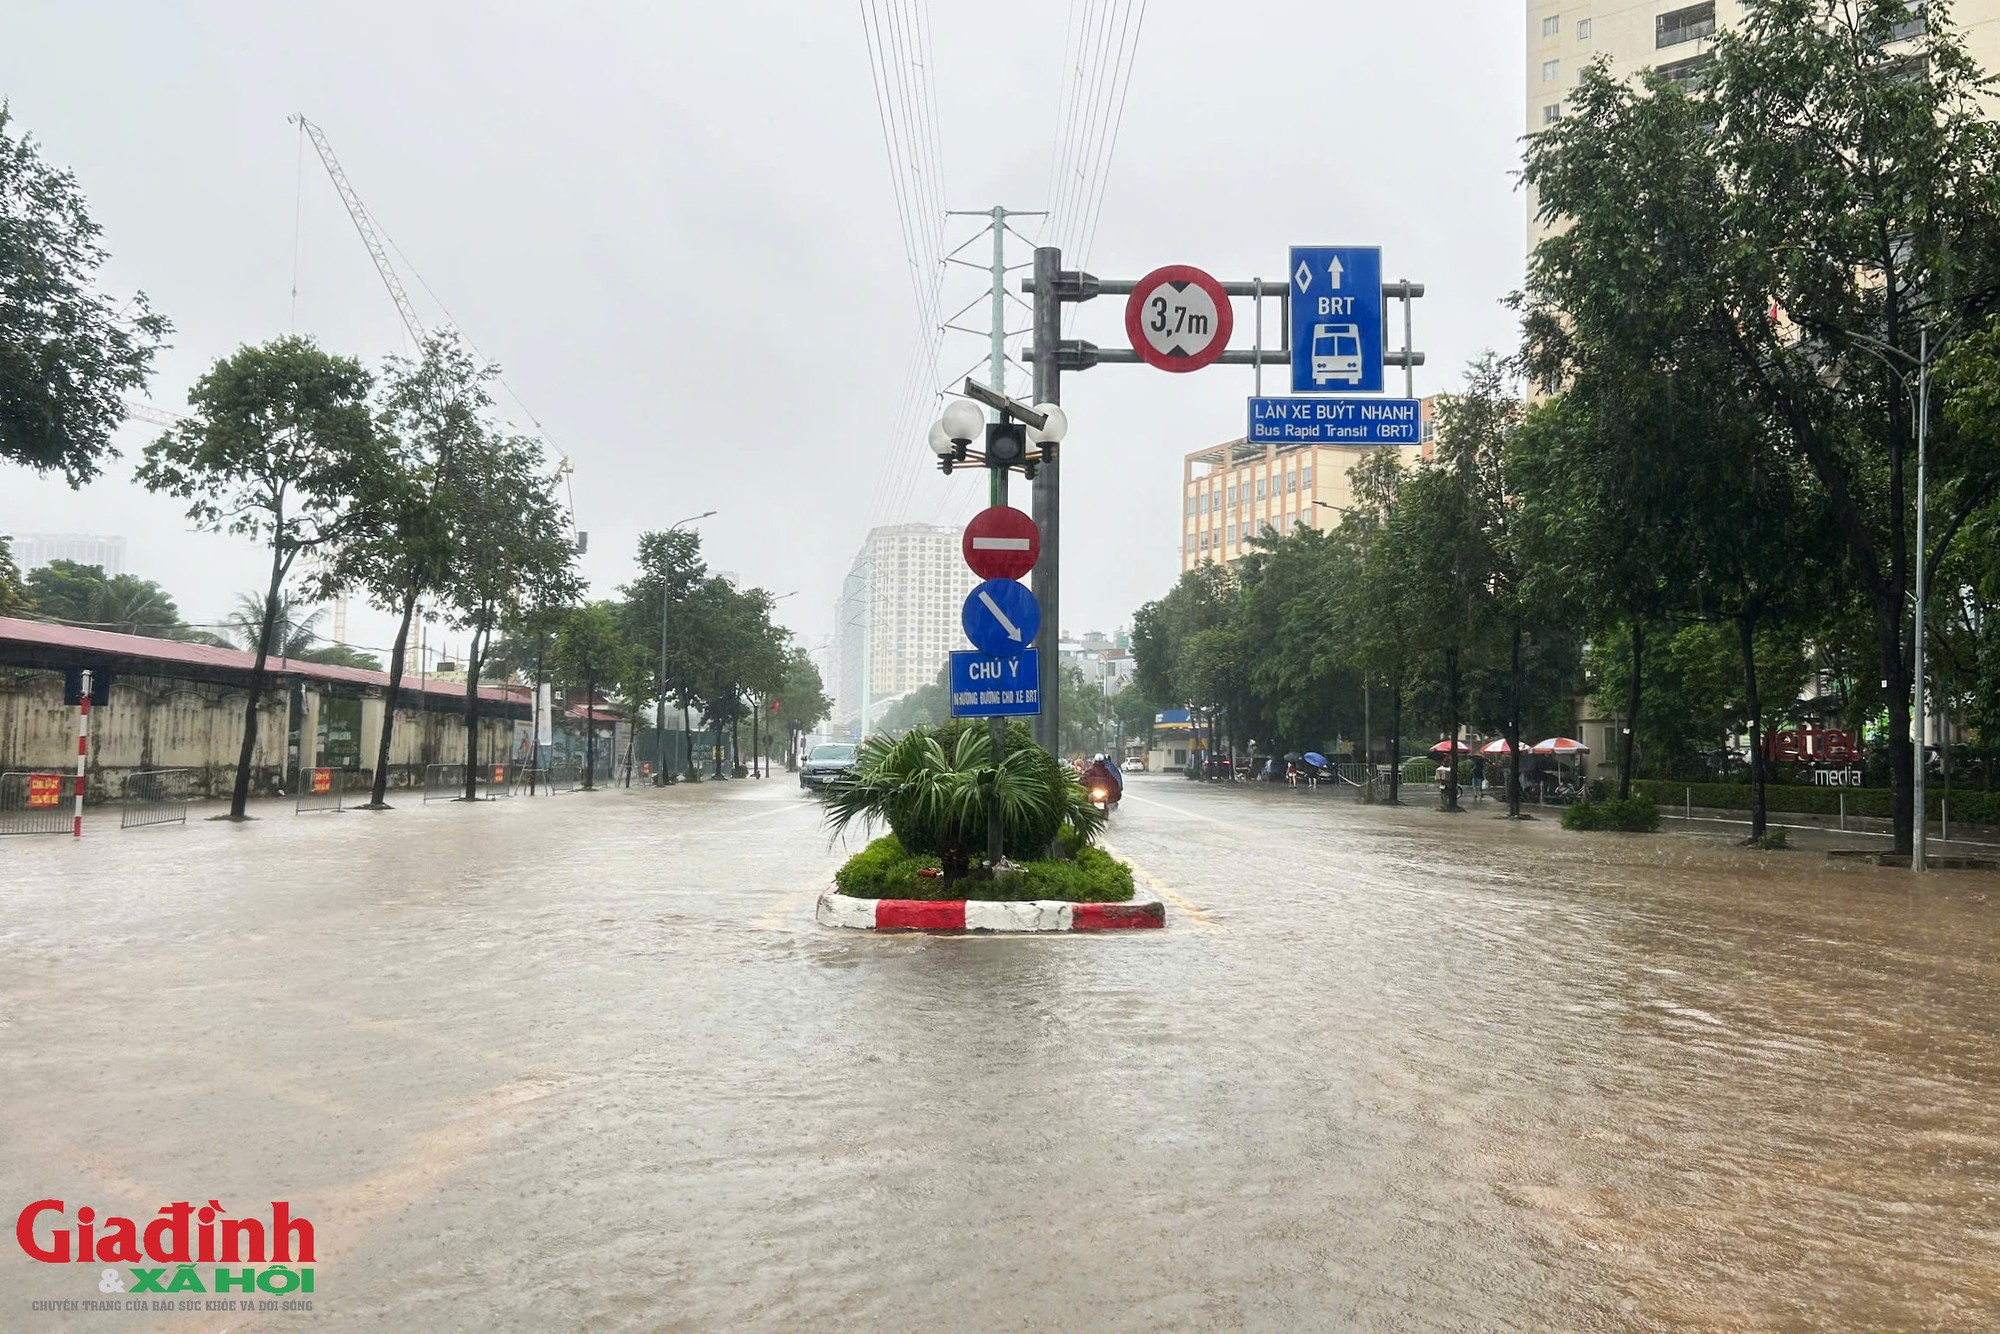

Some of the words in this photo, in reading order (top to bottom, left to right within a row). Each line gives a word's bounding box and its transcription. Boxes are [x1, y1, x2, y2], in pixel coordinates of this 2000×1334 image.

[1318, 297, 1355, 315] BRT
[1151, 297, 1208, 338] 3,7m
[1255, 401, 1287, 420] LÀN
[1292, 405, 1311, 420] XE
[1316, 401, 1355, 420] BUÝT
[1361, 405, 1414, 421] NHANH
[1255, 424, 1280, 437] Bus
[1285, 424, 1319, 439] Rapid
[1325, 424, 1368, 438] Transit
[1376, 424, 1413, 438] (BRT)
[969, 657, 1001, 680] CHÚ
[1009, 656, 1019, 678] Ý
[1001, 690, 1014, 705] CHO
[1015, 689, 1024, 704] XE
[1025, 689, 1038, 703] BRT
[1814, 766, 1862, 786] media
